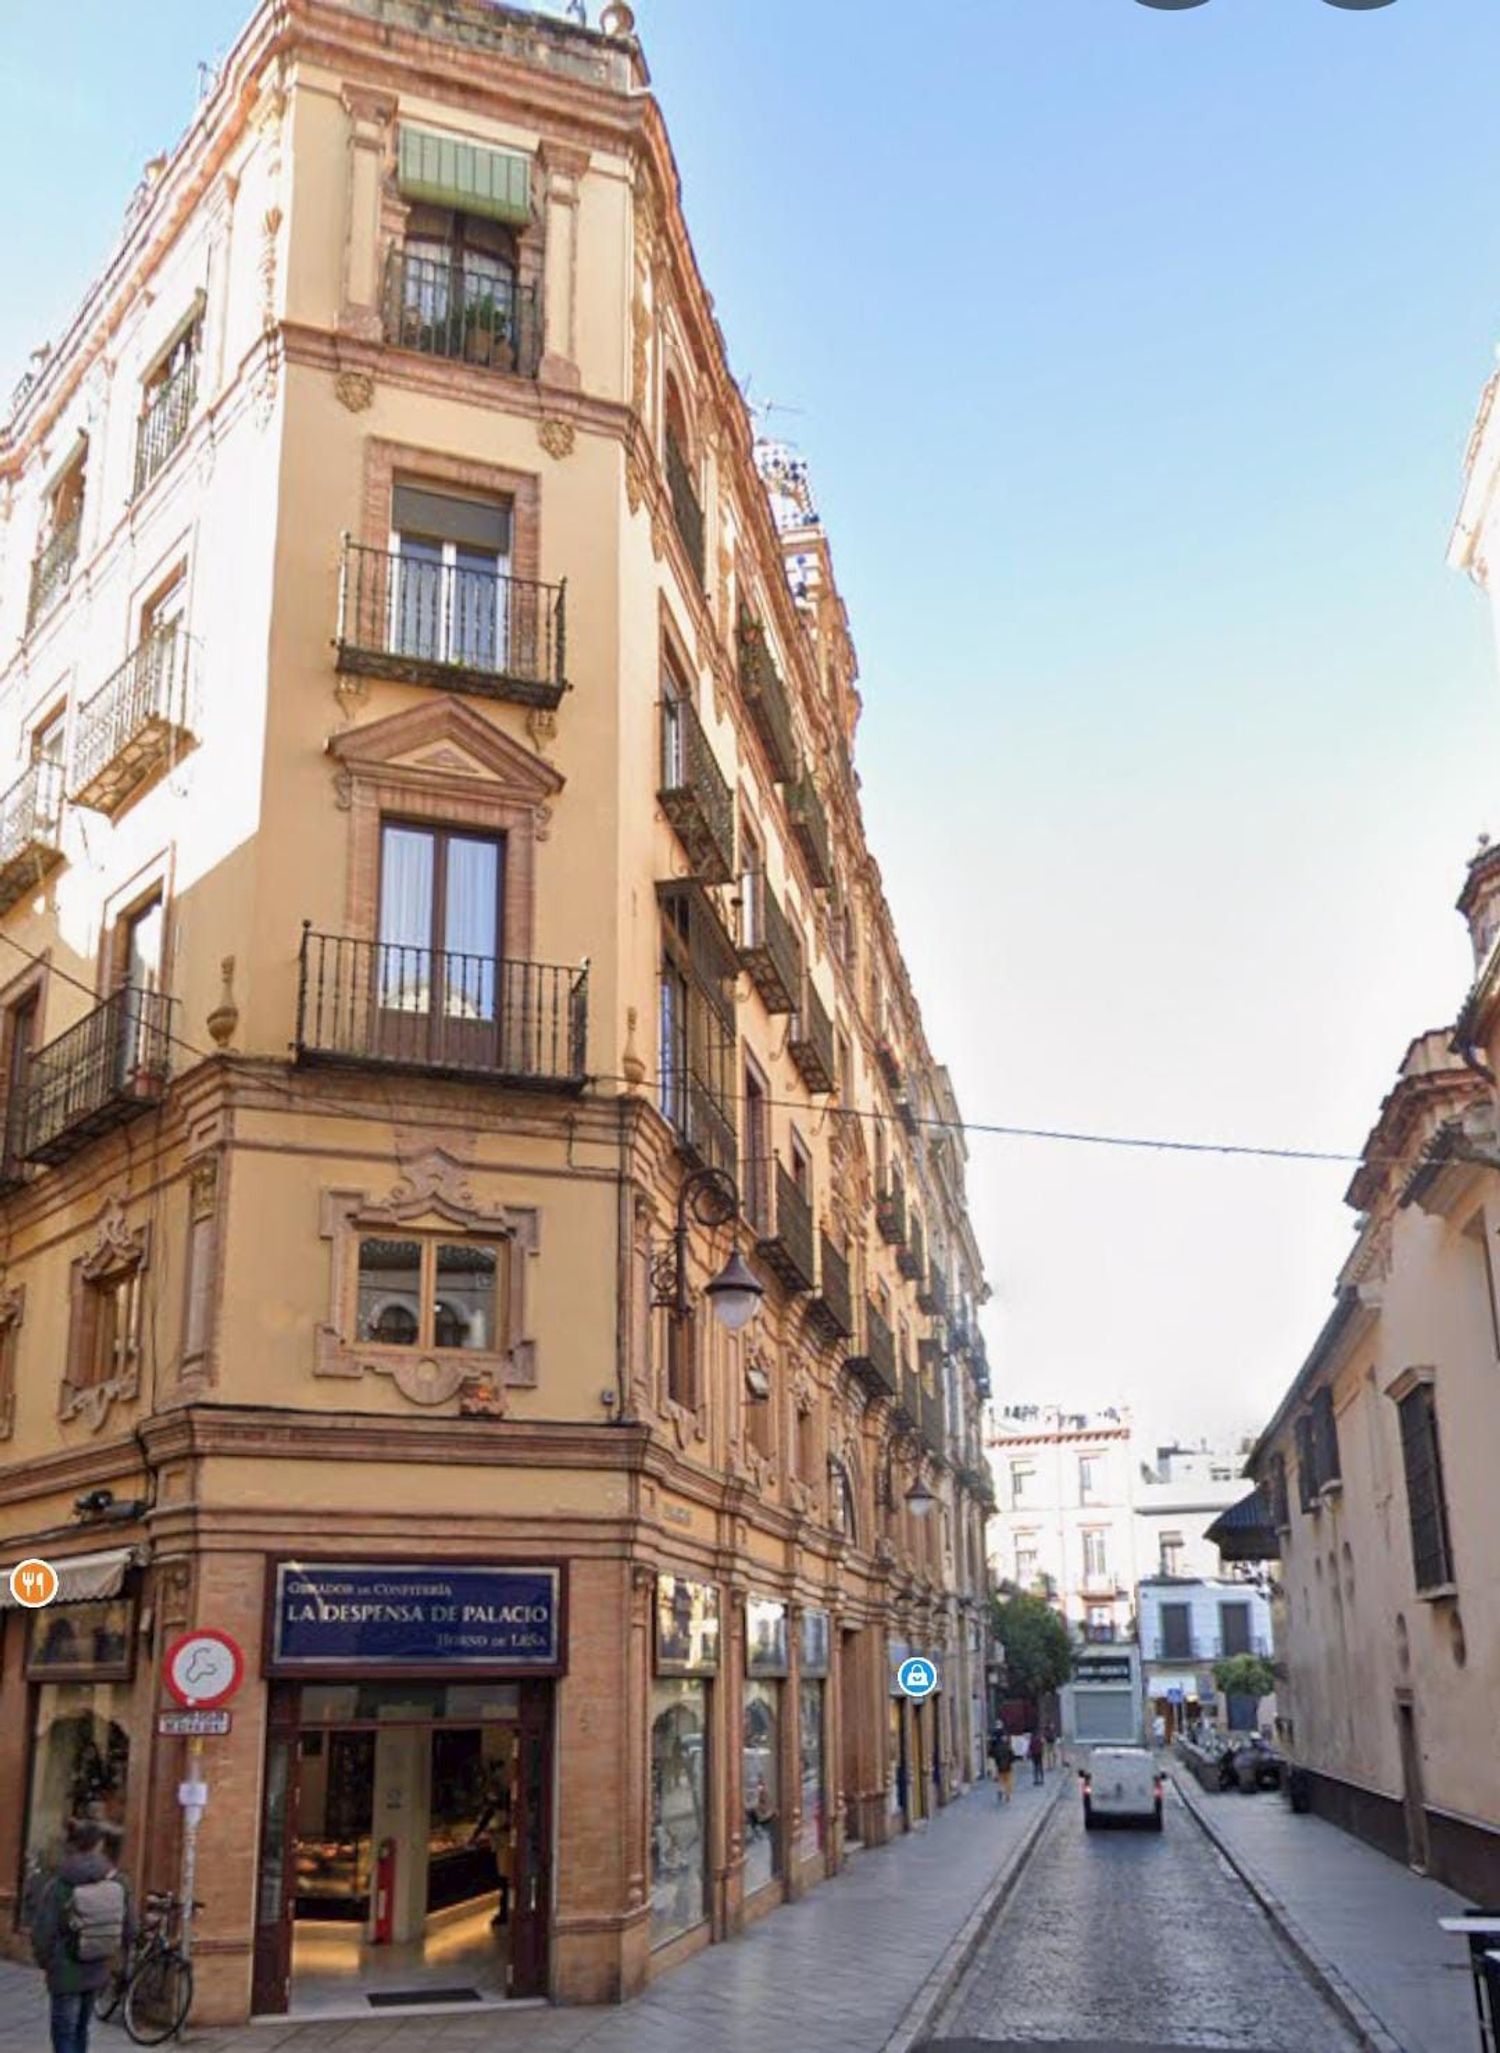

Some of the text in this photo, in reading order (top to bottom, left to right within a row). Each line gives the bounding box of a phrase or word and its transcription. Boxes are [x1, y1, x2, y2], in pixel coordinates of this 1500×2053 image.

[288, 1604, 549, 1623] LA DESPENSA DE PALACIO
